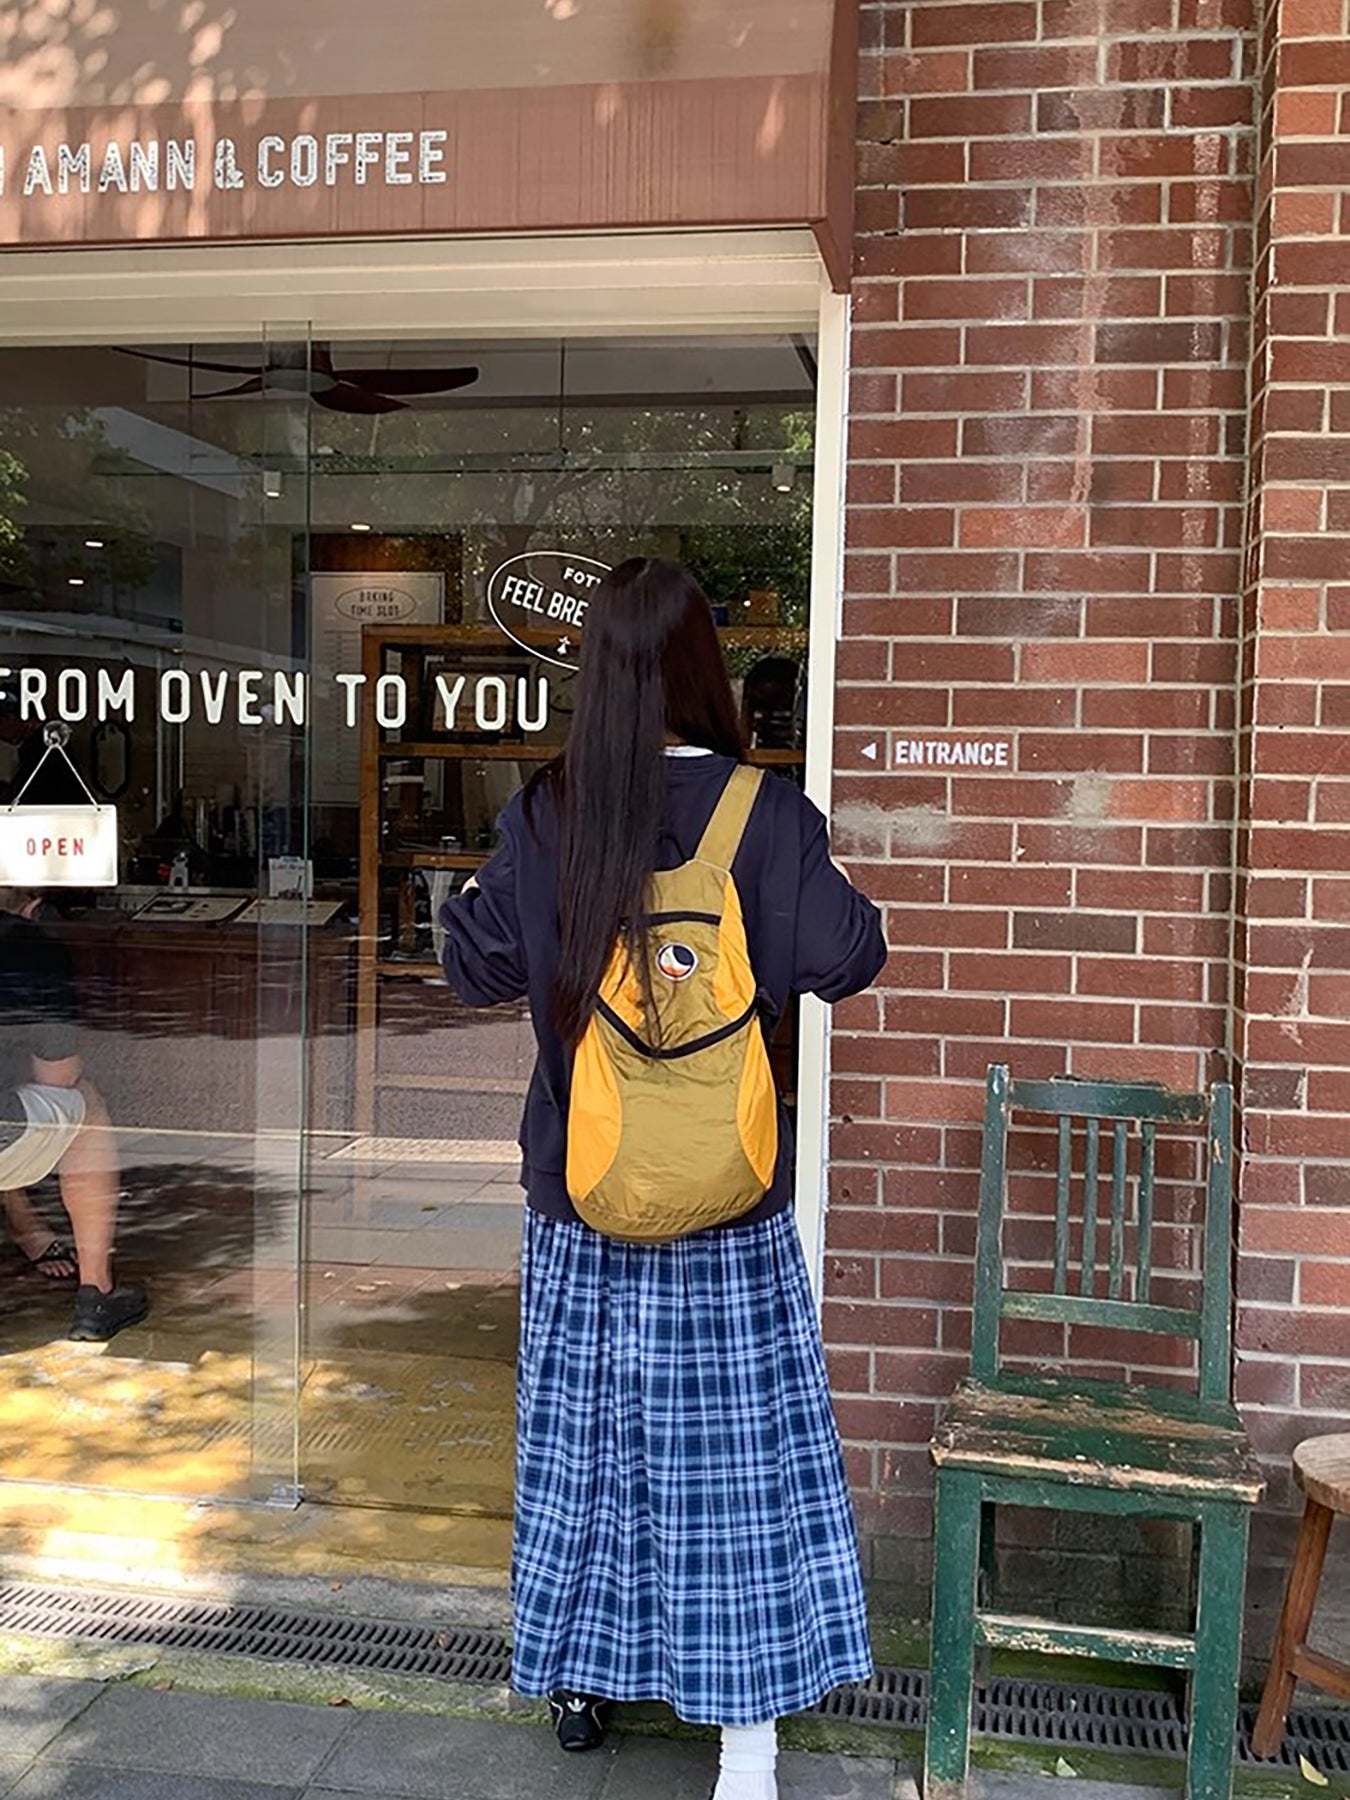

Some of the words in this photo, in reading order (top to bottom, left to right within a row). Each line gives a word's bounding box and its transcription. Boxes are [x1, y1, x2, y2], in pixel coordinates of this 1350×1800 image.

[23, 140, 195, 195] AMANN
[214, 137, 244, 189] &
[257, 131, 448, 188] COFFEE
[563, 567, 602, 588] FOT
[501, 575, 544, 614] FEEL
[547, 591, 589, 627] BRE
[161, 670, 304, 725] OVEN
[335, 674, 407, 729] TO
[435, 675, 549, 732] YOU
[895, 740, 1008, 766] ENTRANCE
[26, 838, 84, 856] OPEN
